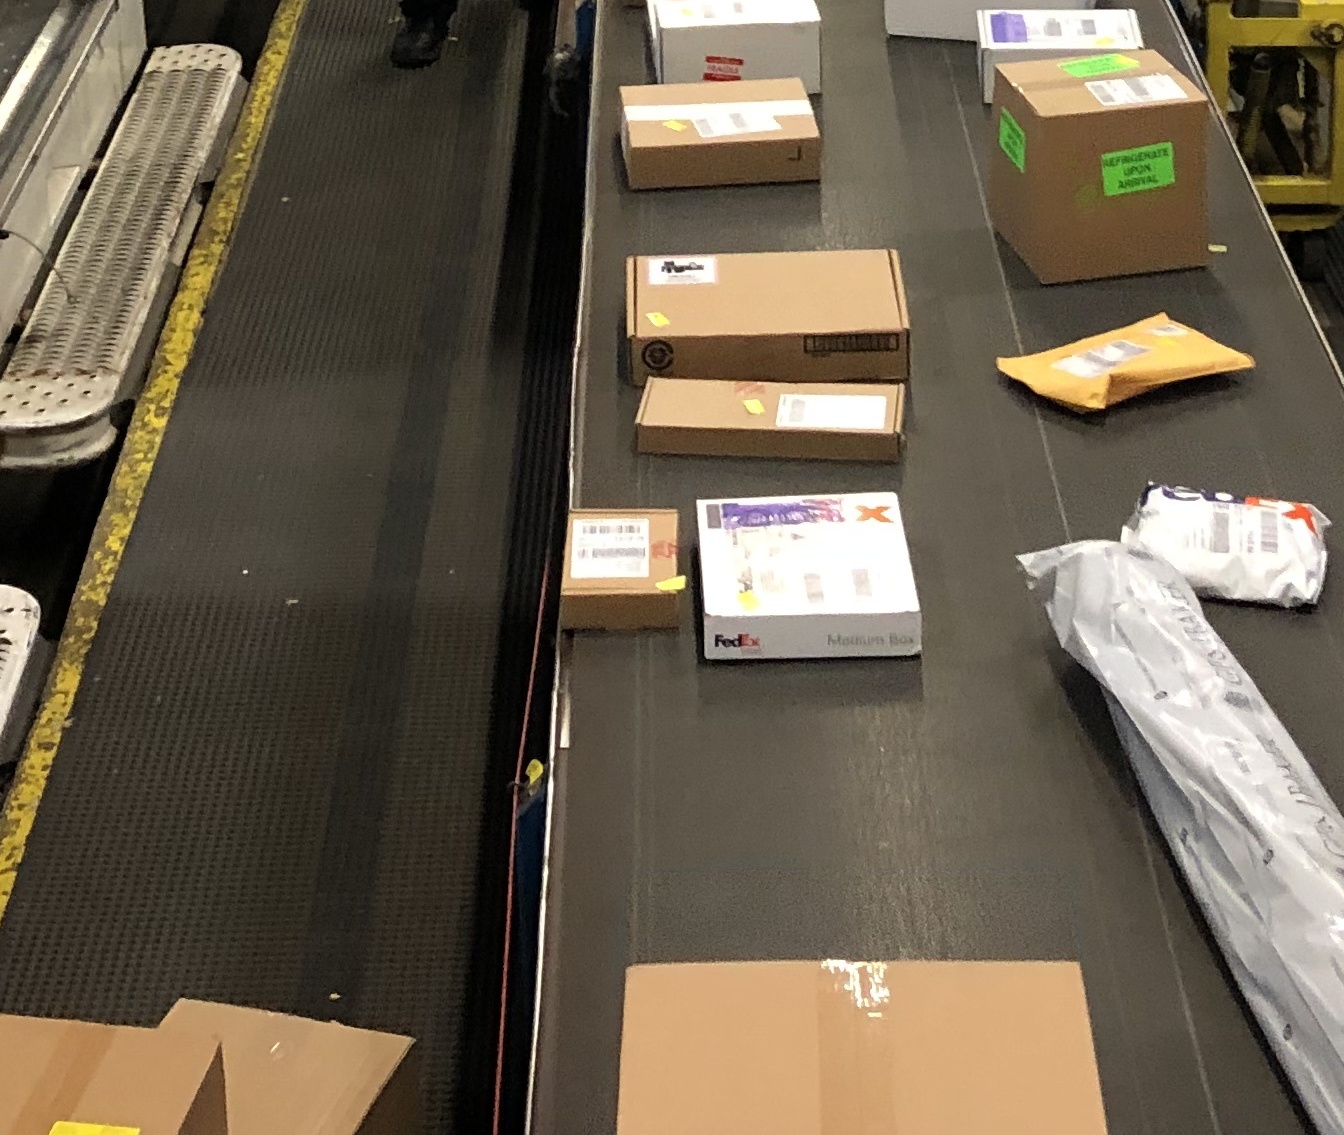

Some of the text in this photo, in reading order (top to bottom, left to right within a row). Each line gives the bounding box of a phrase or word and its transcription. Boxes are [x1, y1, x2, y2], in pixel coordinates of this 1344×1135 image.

[713, 632, 761, 649] FedEx
[827, 632, 915, 647] Medium Box
